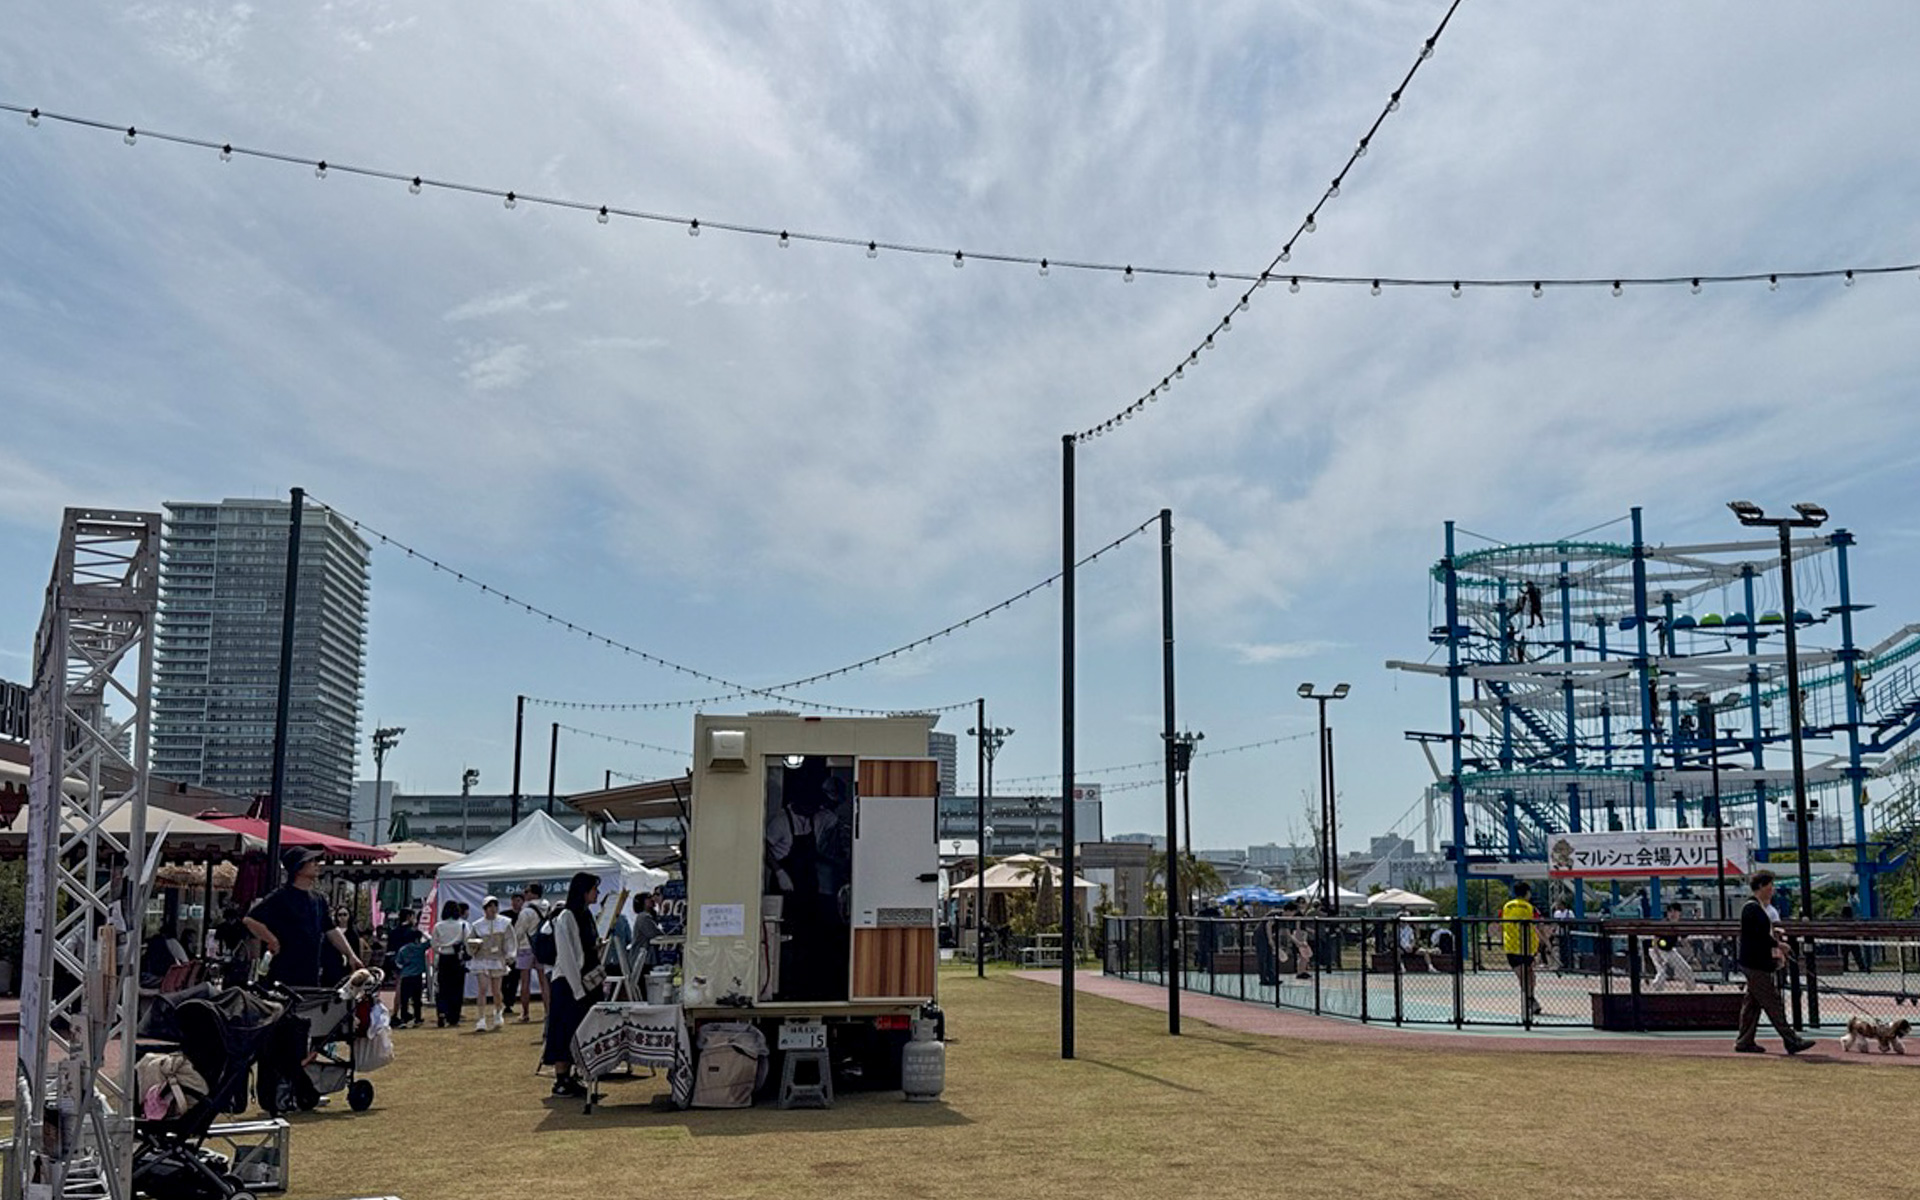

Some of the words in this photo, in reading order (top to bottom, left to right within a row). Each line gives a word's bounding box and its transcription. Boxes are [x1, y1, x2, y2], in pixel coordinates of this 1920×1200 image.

[1575, 846, 1719, 867] マルシェ会場入り口
